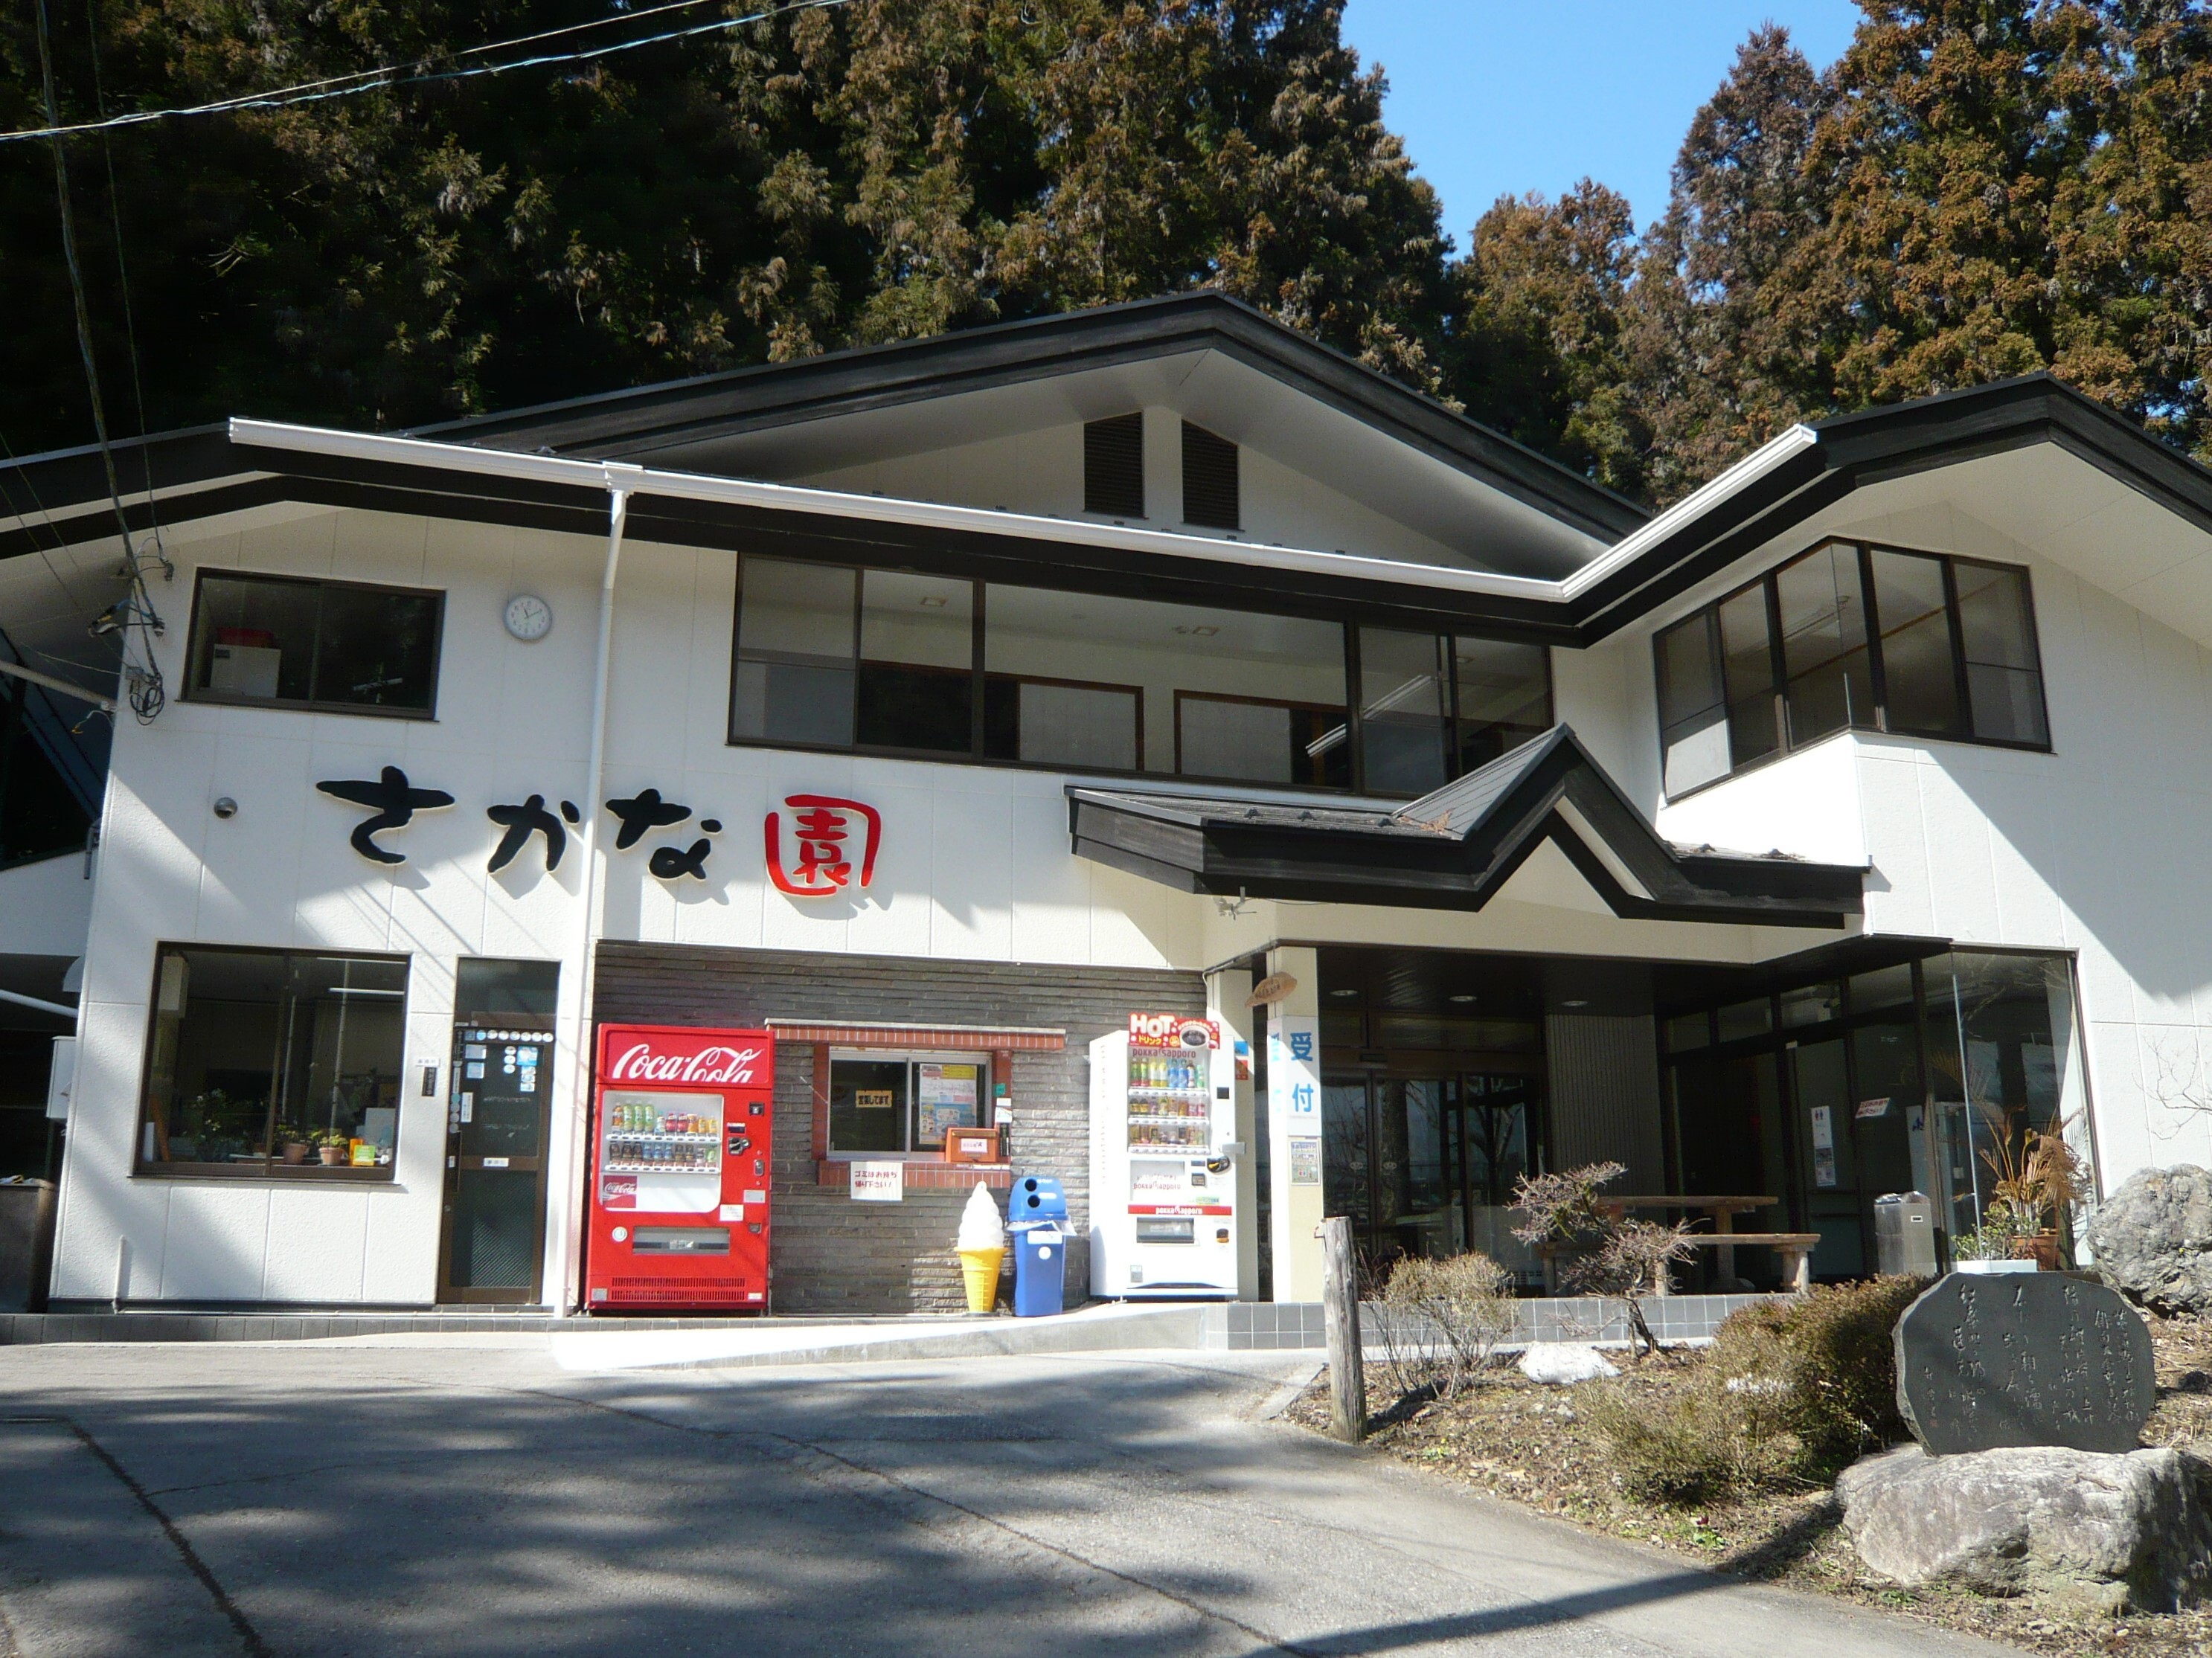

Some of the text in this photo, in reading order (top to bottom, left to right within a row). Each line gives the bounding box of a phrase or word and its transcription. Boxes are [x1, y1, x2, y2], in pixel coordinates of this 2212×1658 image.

[1130, 1014, 1176, 1038] HOT
[1138, 1035, 1161, 1045] ドリンク
[613, 1044, 764, 1083] Coca-Cola
[1290, 1032, 1314, 1113] 受付
